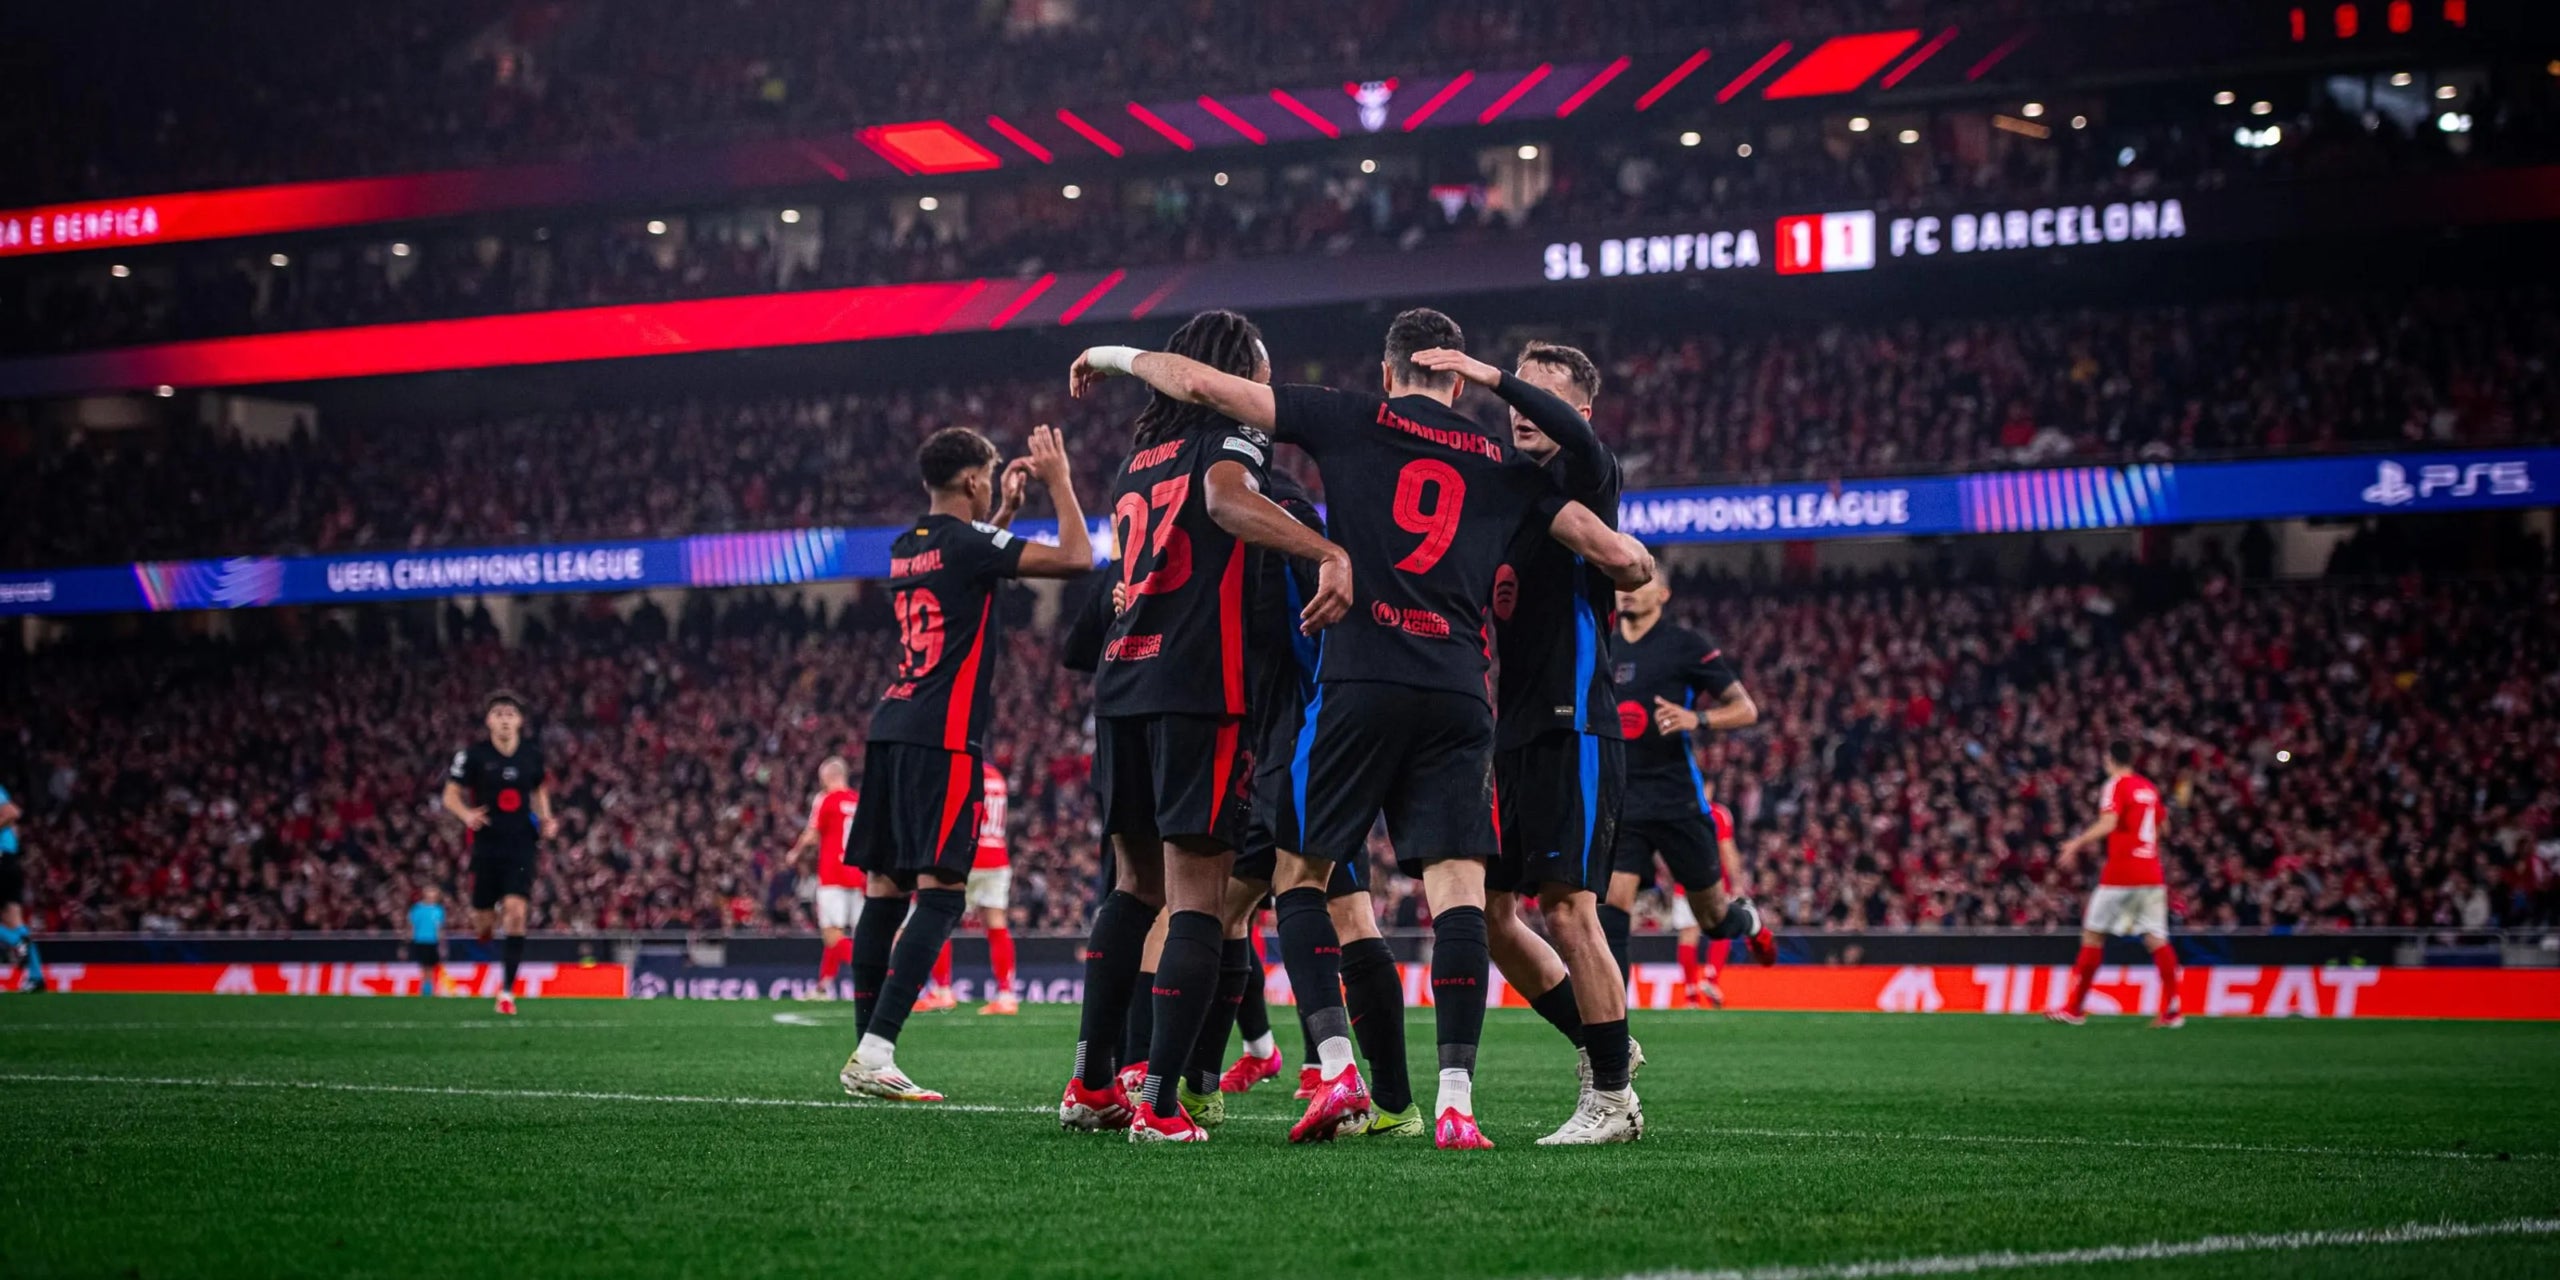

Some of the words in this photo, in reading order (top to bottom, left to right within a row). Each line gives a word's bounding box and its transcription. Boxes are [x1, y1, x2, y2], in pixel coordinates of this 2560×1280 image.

[0, 218, 21, 247] A
[1544, 241, 1590, 280] SL
[1600, 229, 1761, 277] BENFICA
[1890, 216, 1941, 257] FC
[1951, 199, 2186, 253] BARCELONA
[1376, 402, 1503, 463] LEWANDOWSKI
[2419, 461, 2532, 498] PS5
[1392, 458, 1466, 576] 9
[1777, 489, 1910, 529] LEAGUE
[1115, 473, 1192, 612] 23
[327, 560, 392, 592] UEFA
[393, 553, 542, 590] CHAMPIONS
[543, 548, 644, 583] LEAGUE
[893, 586, 945, 679] 19
[1236, 750, 1256, 801] 2
[2204, 965, 2380, 1018] EAT
